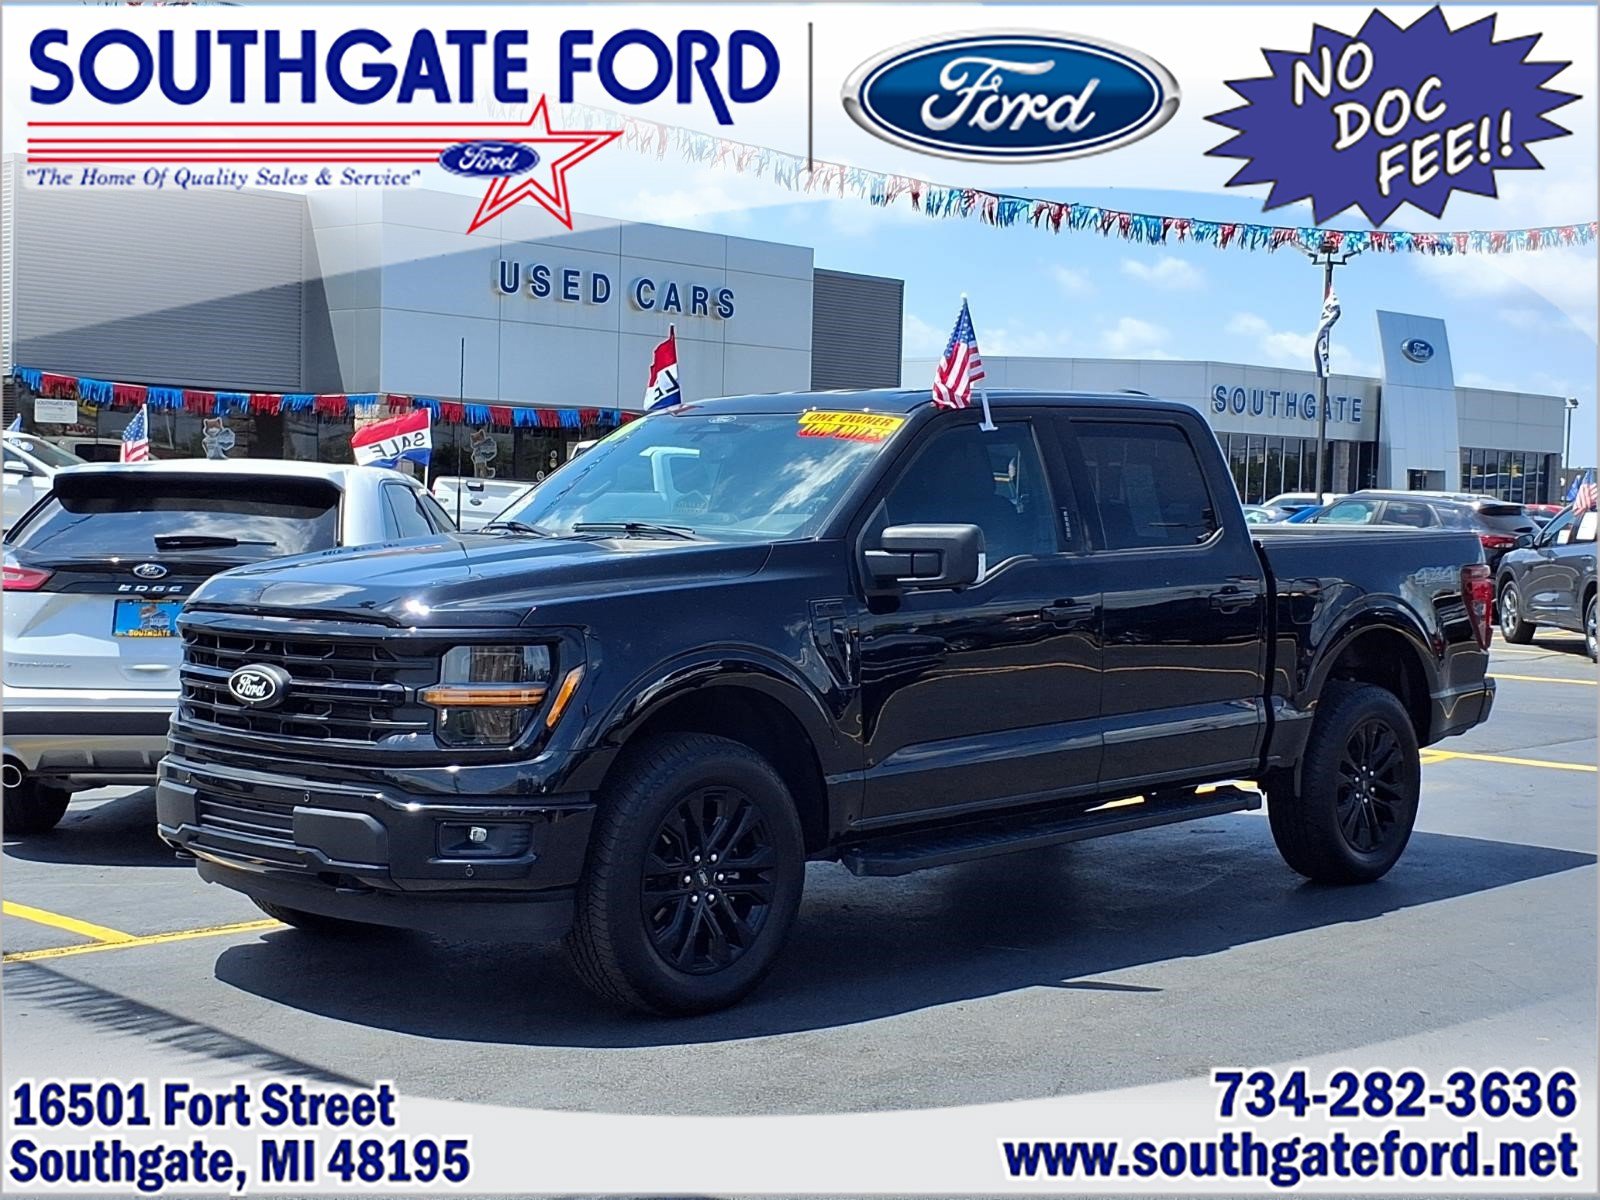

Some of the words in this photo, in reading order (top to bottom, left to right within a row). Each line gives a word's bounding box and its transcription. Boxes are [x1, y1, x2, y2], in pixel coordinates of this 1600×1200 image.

[499, 260, 612, 304] USED
[634, 277, 735, 320] CARS
[1213, 384, 1362, 422] SOUTHGATE
[807, 413, 838, 422] ONE
[841, 415, 895, 427] OWNER
[118, 584, 183, 592] EDGE
[236, 674, 267, 697] Ford
